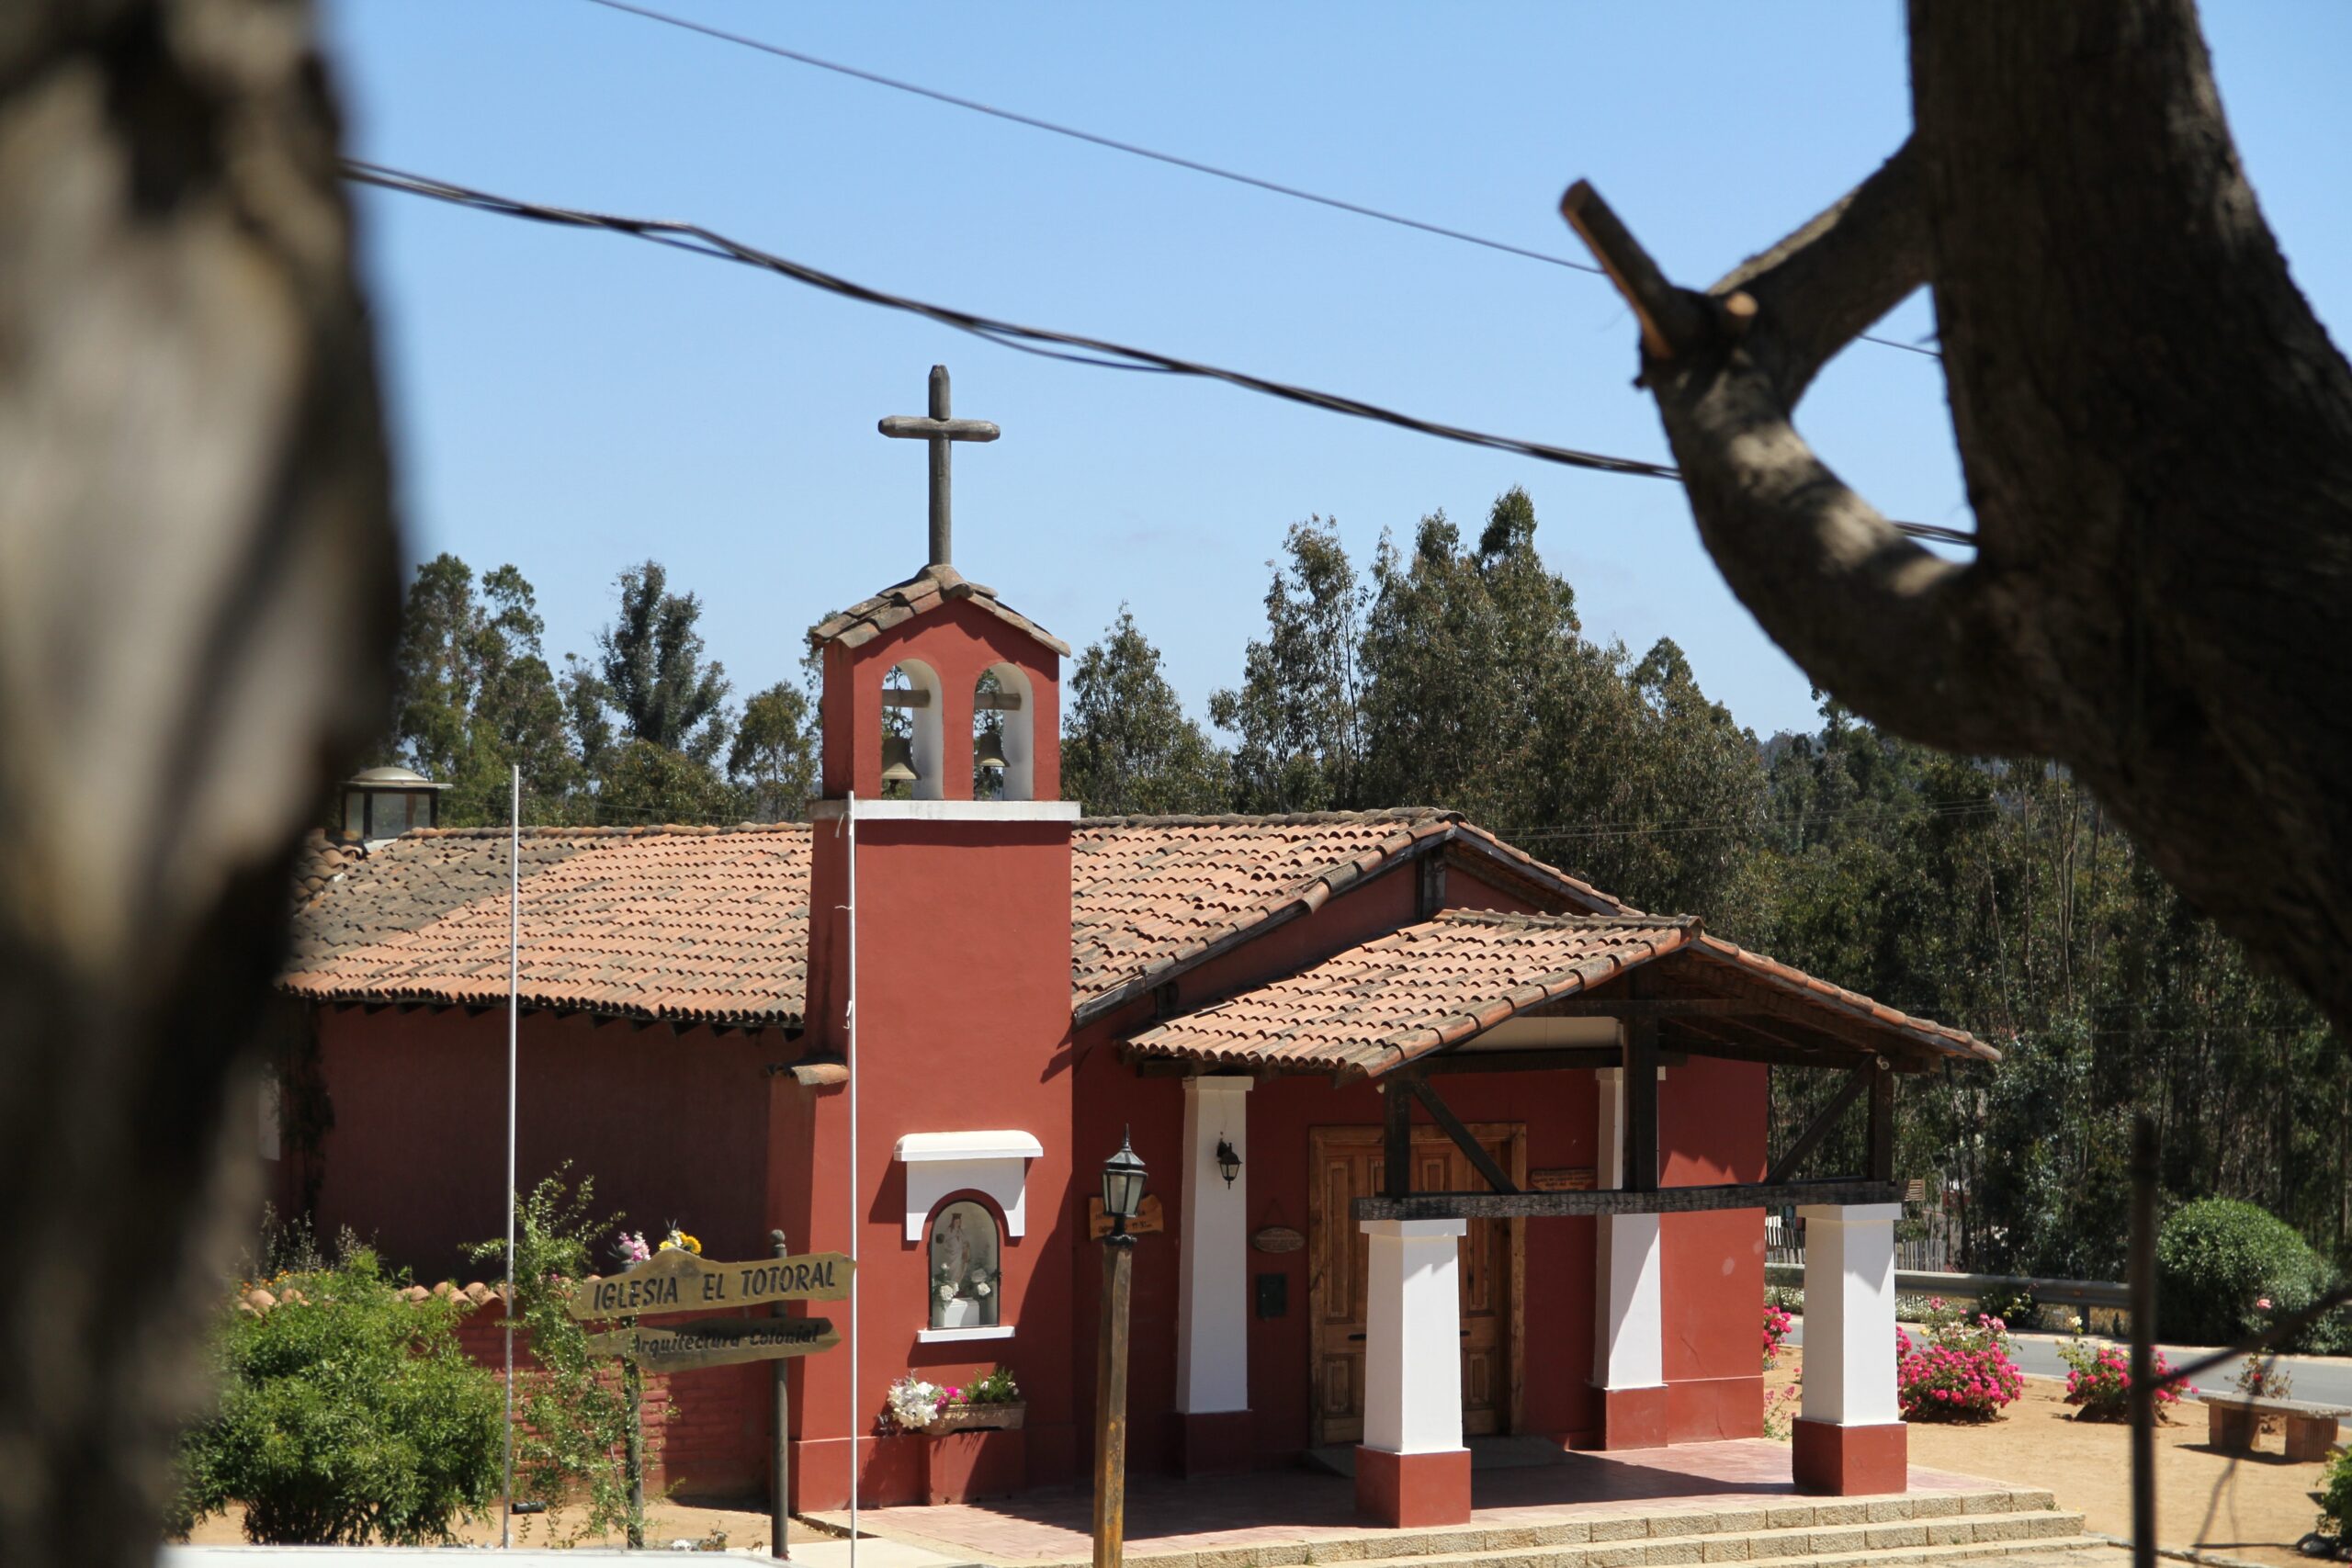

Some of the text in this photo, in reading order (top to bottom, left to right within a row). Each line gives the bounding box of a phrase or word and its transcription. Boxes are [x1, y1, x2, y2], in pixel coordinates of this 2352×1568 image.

[594, 1261, 836, 1311] IGLESIA EL TOTORAL
[750, 1325, 820, 1347] Colonial
